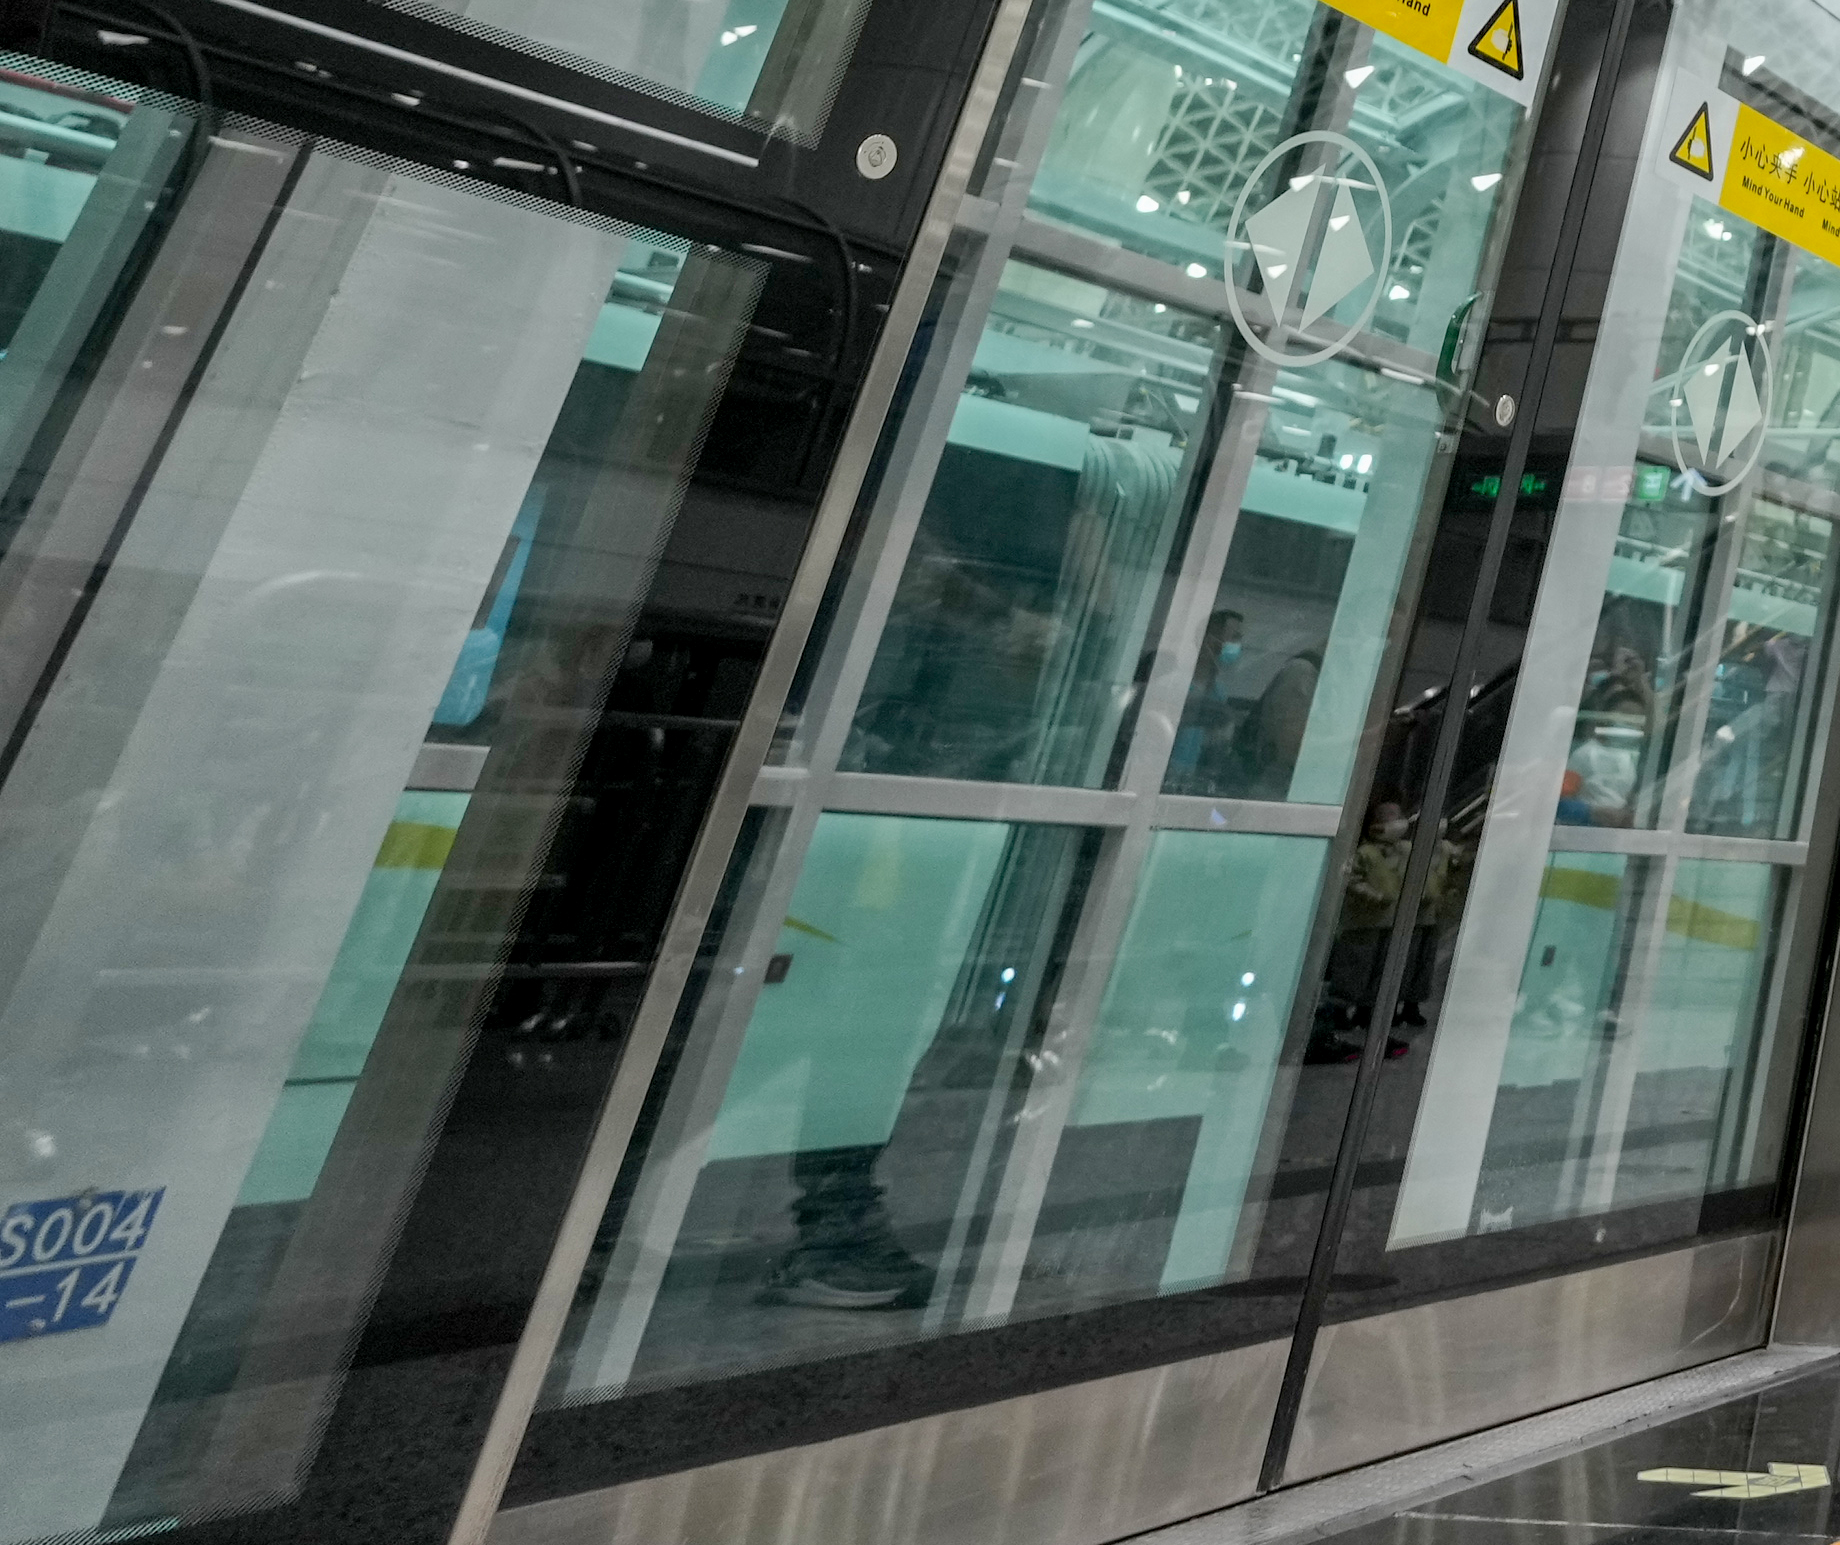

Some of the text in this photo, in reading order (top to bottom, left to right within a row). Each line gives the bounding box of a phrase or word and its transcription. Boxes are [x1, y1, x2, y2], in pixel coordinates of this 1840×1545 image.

[1740, 136, 1799, 185] 小心夹手
[1742, 175, 1806, 219] Mind Your Hand
[1821, 218, 1840, 238] Mind
